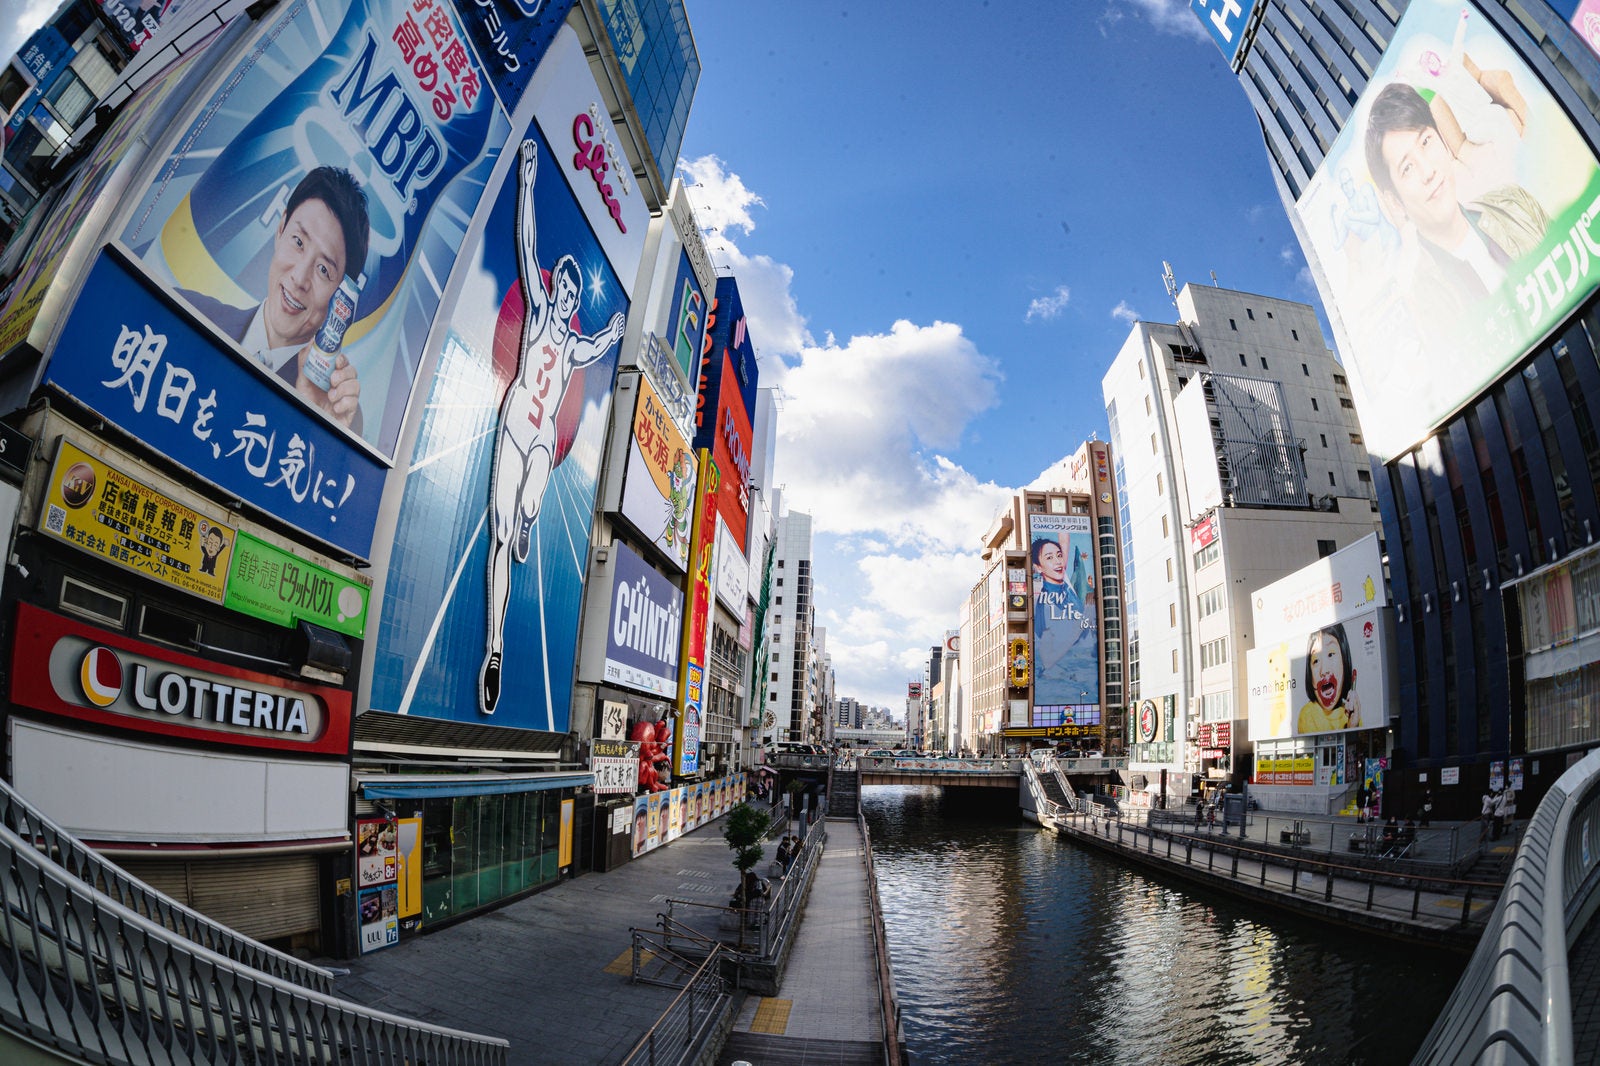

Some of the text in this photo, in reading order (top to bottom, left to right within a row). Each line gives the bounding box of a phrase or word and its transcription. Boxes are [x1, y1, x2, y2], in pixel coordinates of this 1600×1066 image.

[391, 11, 459, 121] 高める
[331, 29, 442, 202] MBP
[573, 113, 627, 234] Glico
[527, 344, 559, 431] グリコ
[637, 410, 670, 474] 改源
[645, 395, 670, 442] かぜに
[101, 479, 196, 541] 店舗情報館
[106, 469, 198, 522] KANSAI INVEST CORPORATION
[65, 524, 169, 578] 株式会社 関西インベスト
[98, 501, 191, 550] 居抜き店舗総合プロデュース
[170, 575, 182, 586] TEL
[278, 561, 335, 617] ピタットハウス
[1039, 591, 1067, 605] new
[134, 663, 310, 735] LOTTERIA
[385, 865, 396, 879] 8F
[387, 929, 397, 942] 7F
